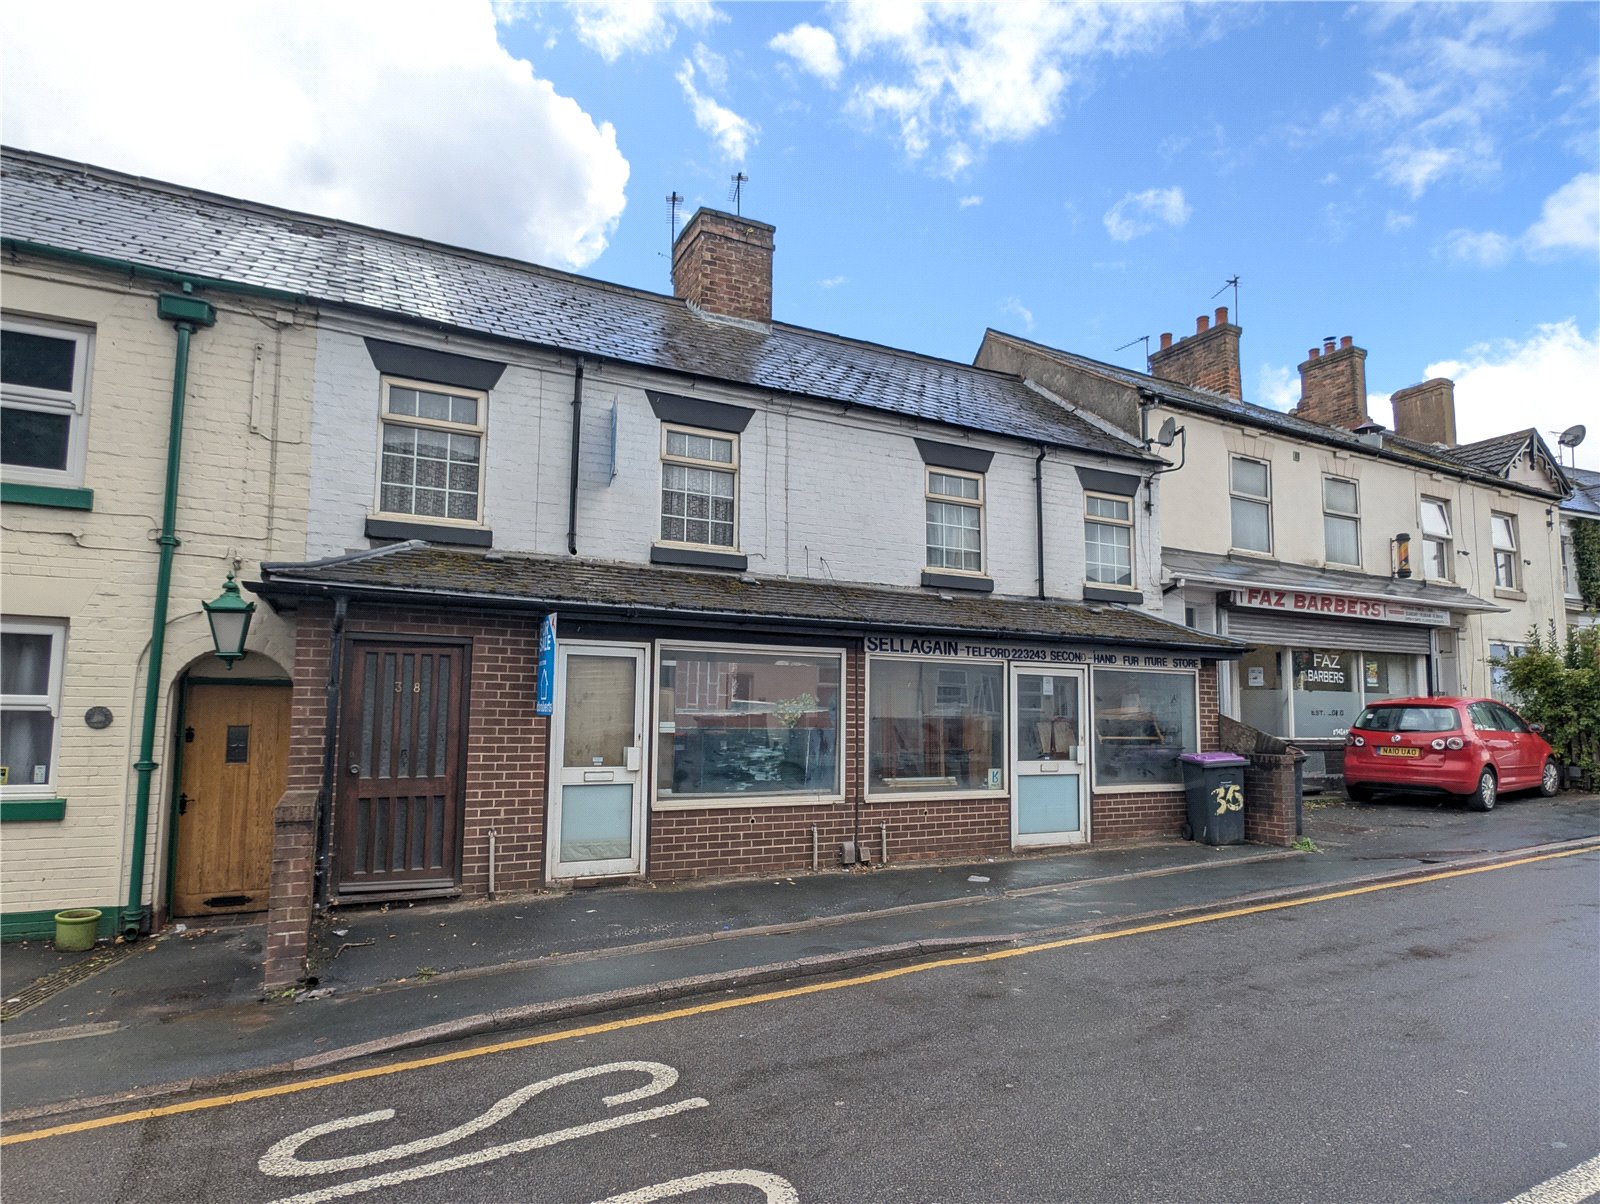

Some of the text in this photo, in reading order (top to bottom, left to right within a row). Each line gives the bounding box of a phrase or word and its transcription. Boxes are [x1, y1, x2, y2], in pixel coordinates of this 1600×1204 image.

[1247, 588, 1286, 607] FAZ
[1293, 593, 1381, 617] BARBERS
[866, 636, 959, 656] SELLAGAIN
[964, 645, 1010, 659] TELFORD
[1011, 648, 1047, 660] 223243
[1172, 658, 1199, 668] STORE
[1313, 653, 1341, 669] FAZ
[1307, 669, 1345, 684] BARBERS
